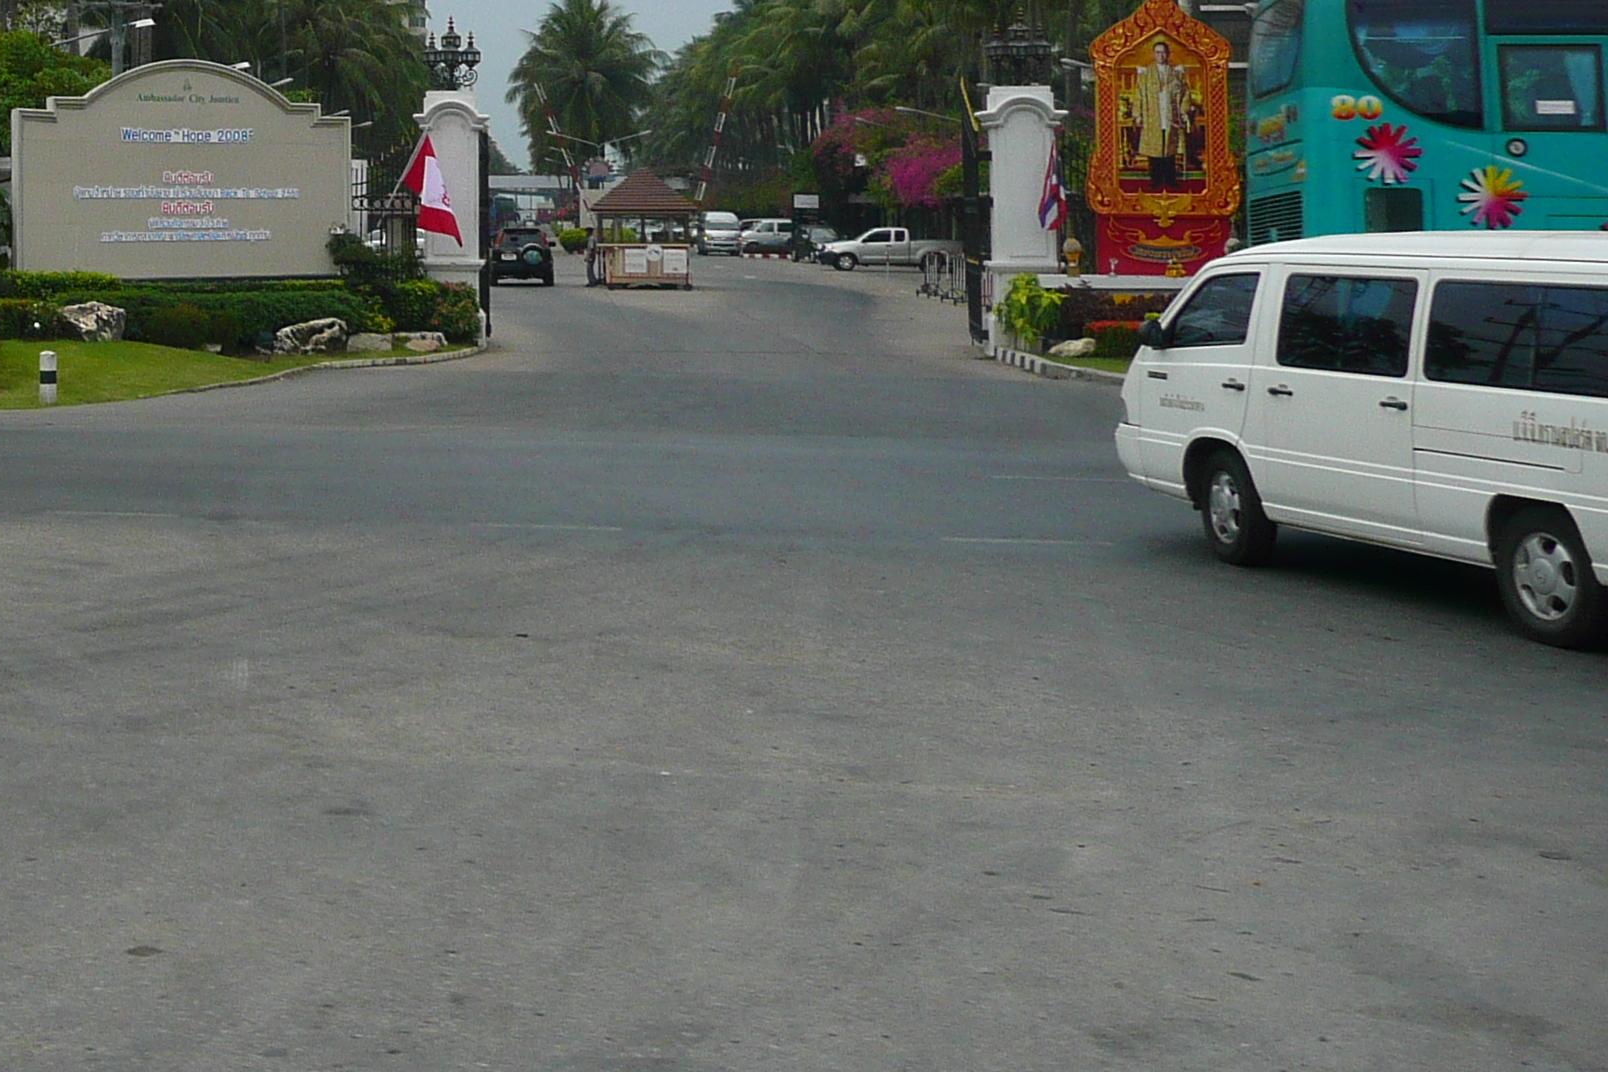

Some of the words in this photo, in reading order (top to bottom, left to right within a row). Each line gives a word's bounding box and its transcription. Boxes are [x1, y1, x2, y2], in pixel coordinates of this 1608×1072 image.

[136, 93, 185, 103] Ambassador
[189, 94, 205, 105] City
[209, 94, 240, 104] Jomtien
[1331, 94, 1383, 121] 80
[121, 128, 171, 142] Welcome
[181, 129, 210, 143] Hope
[215, 129, 247, 142] 2008
